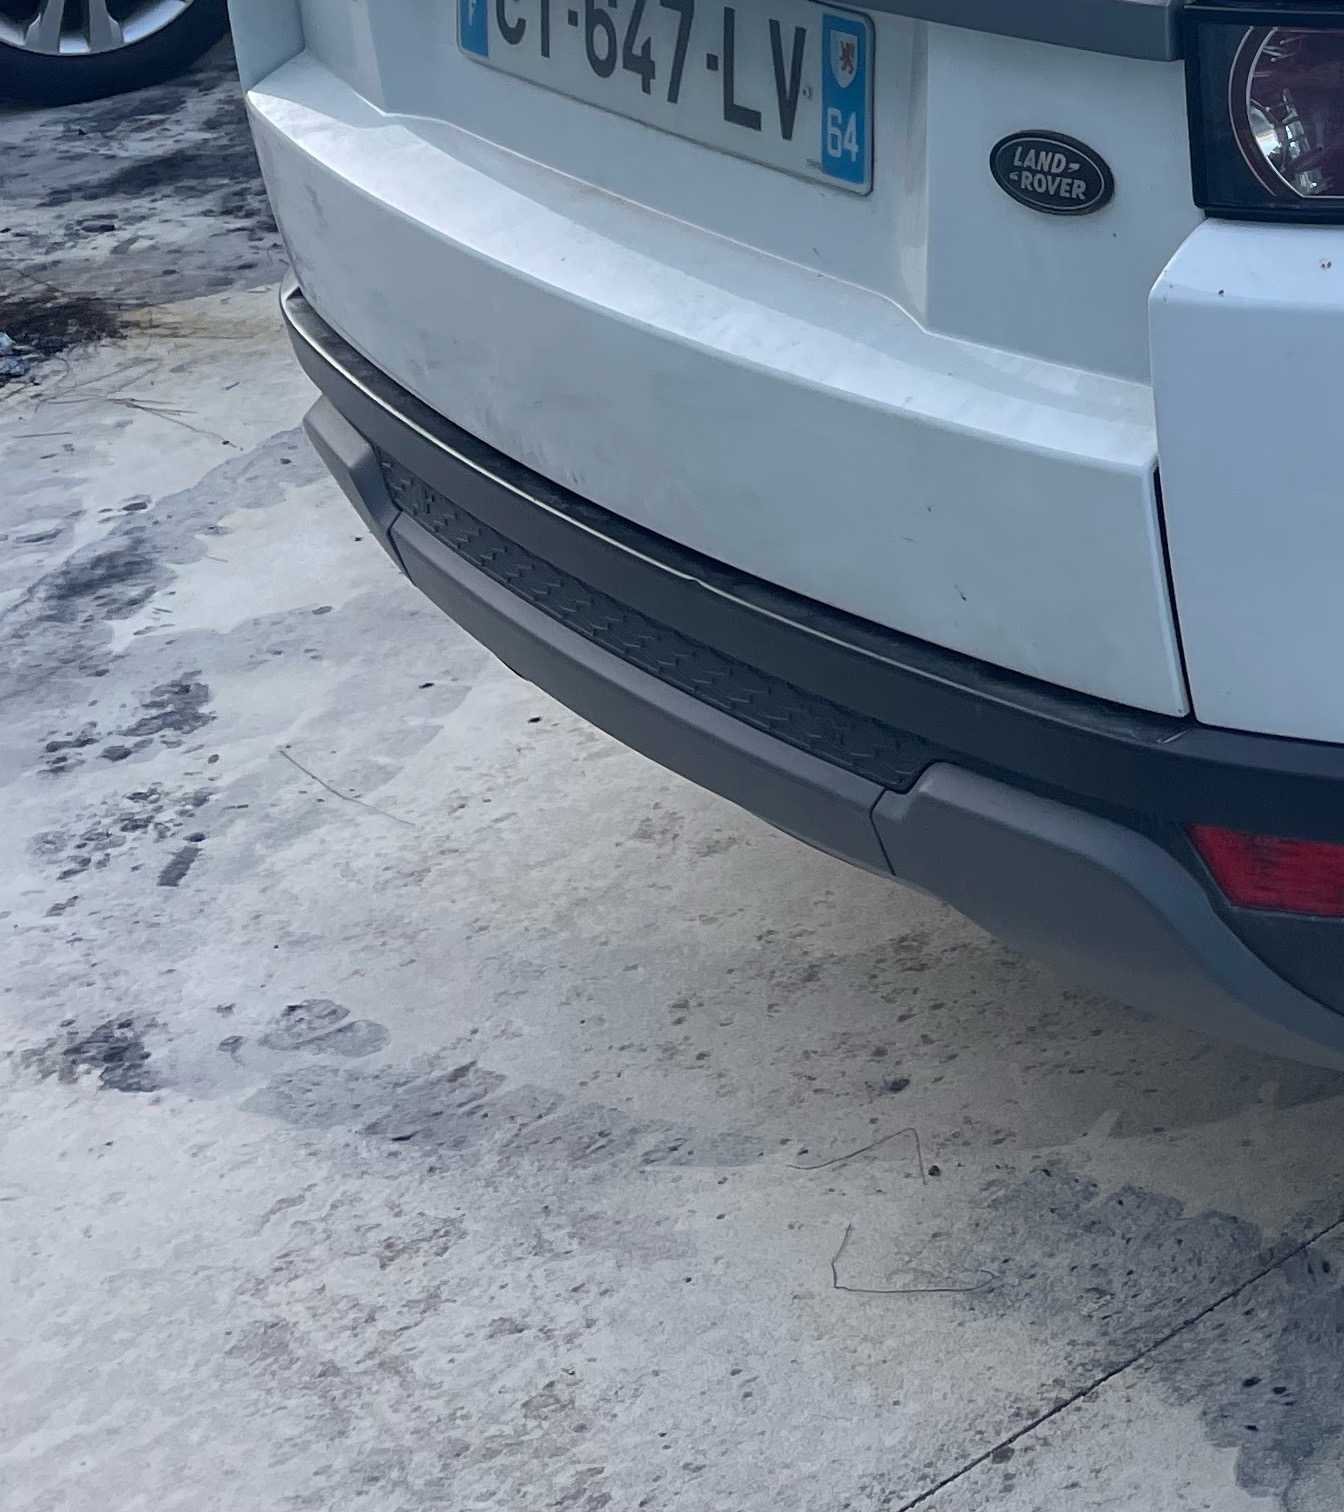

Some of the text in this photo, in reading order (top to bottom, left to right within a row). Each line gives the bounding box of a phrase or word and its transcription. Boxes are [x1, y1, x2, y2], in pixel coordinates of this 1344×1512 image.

[826, 105, 861, 164] 64
[1013, 146, 1067, 174] LAND
[1020, 170, 1087, 200] ROVER
